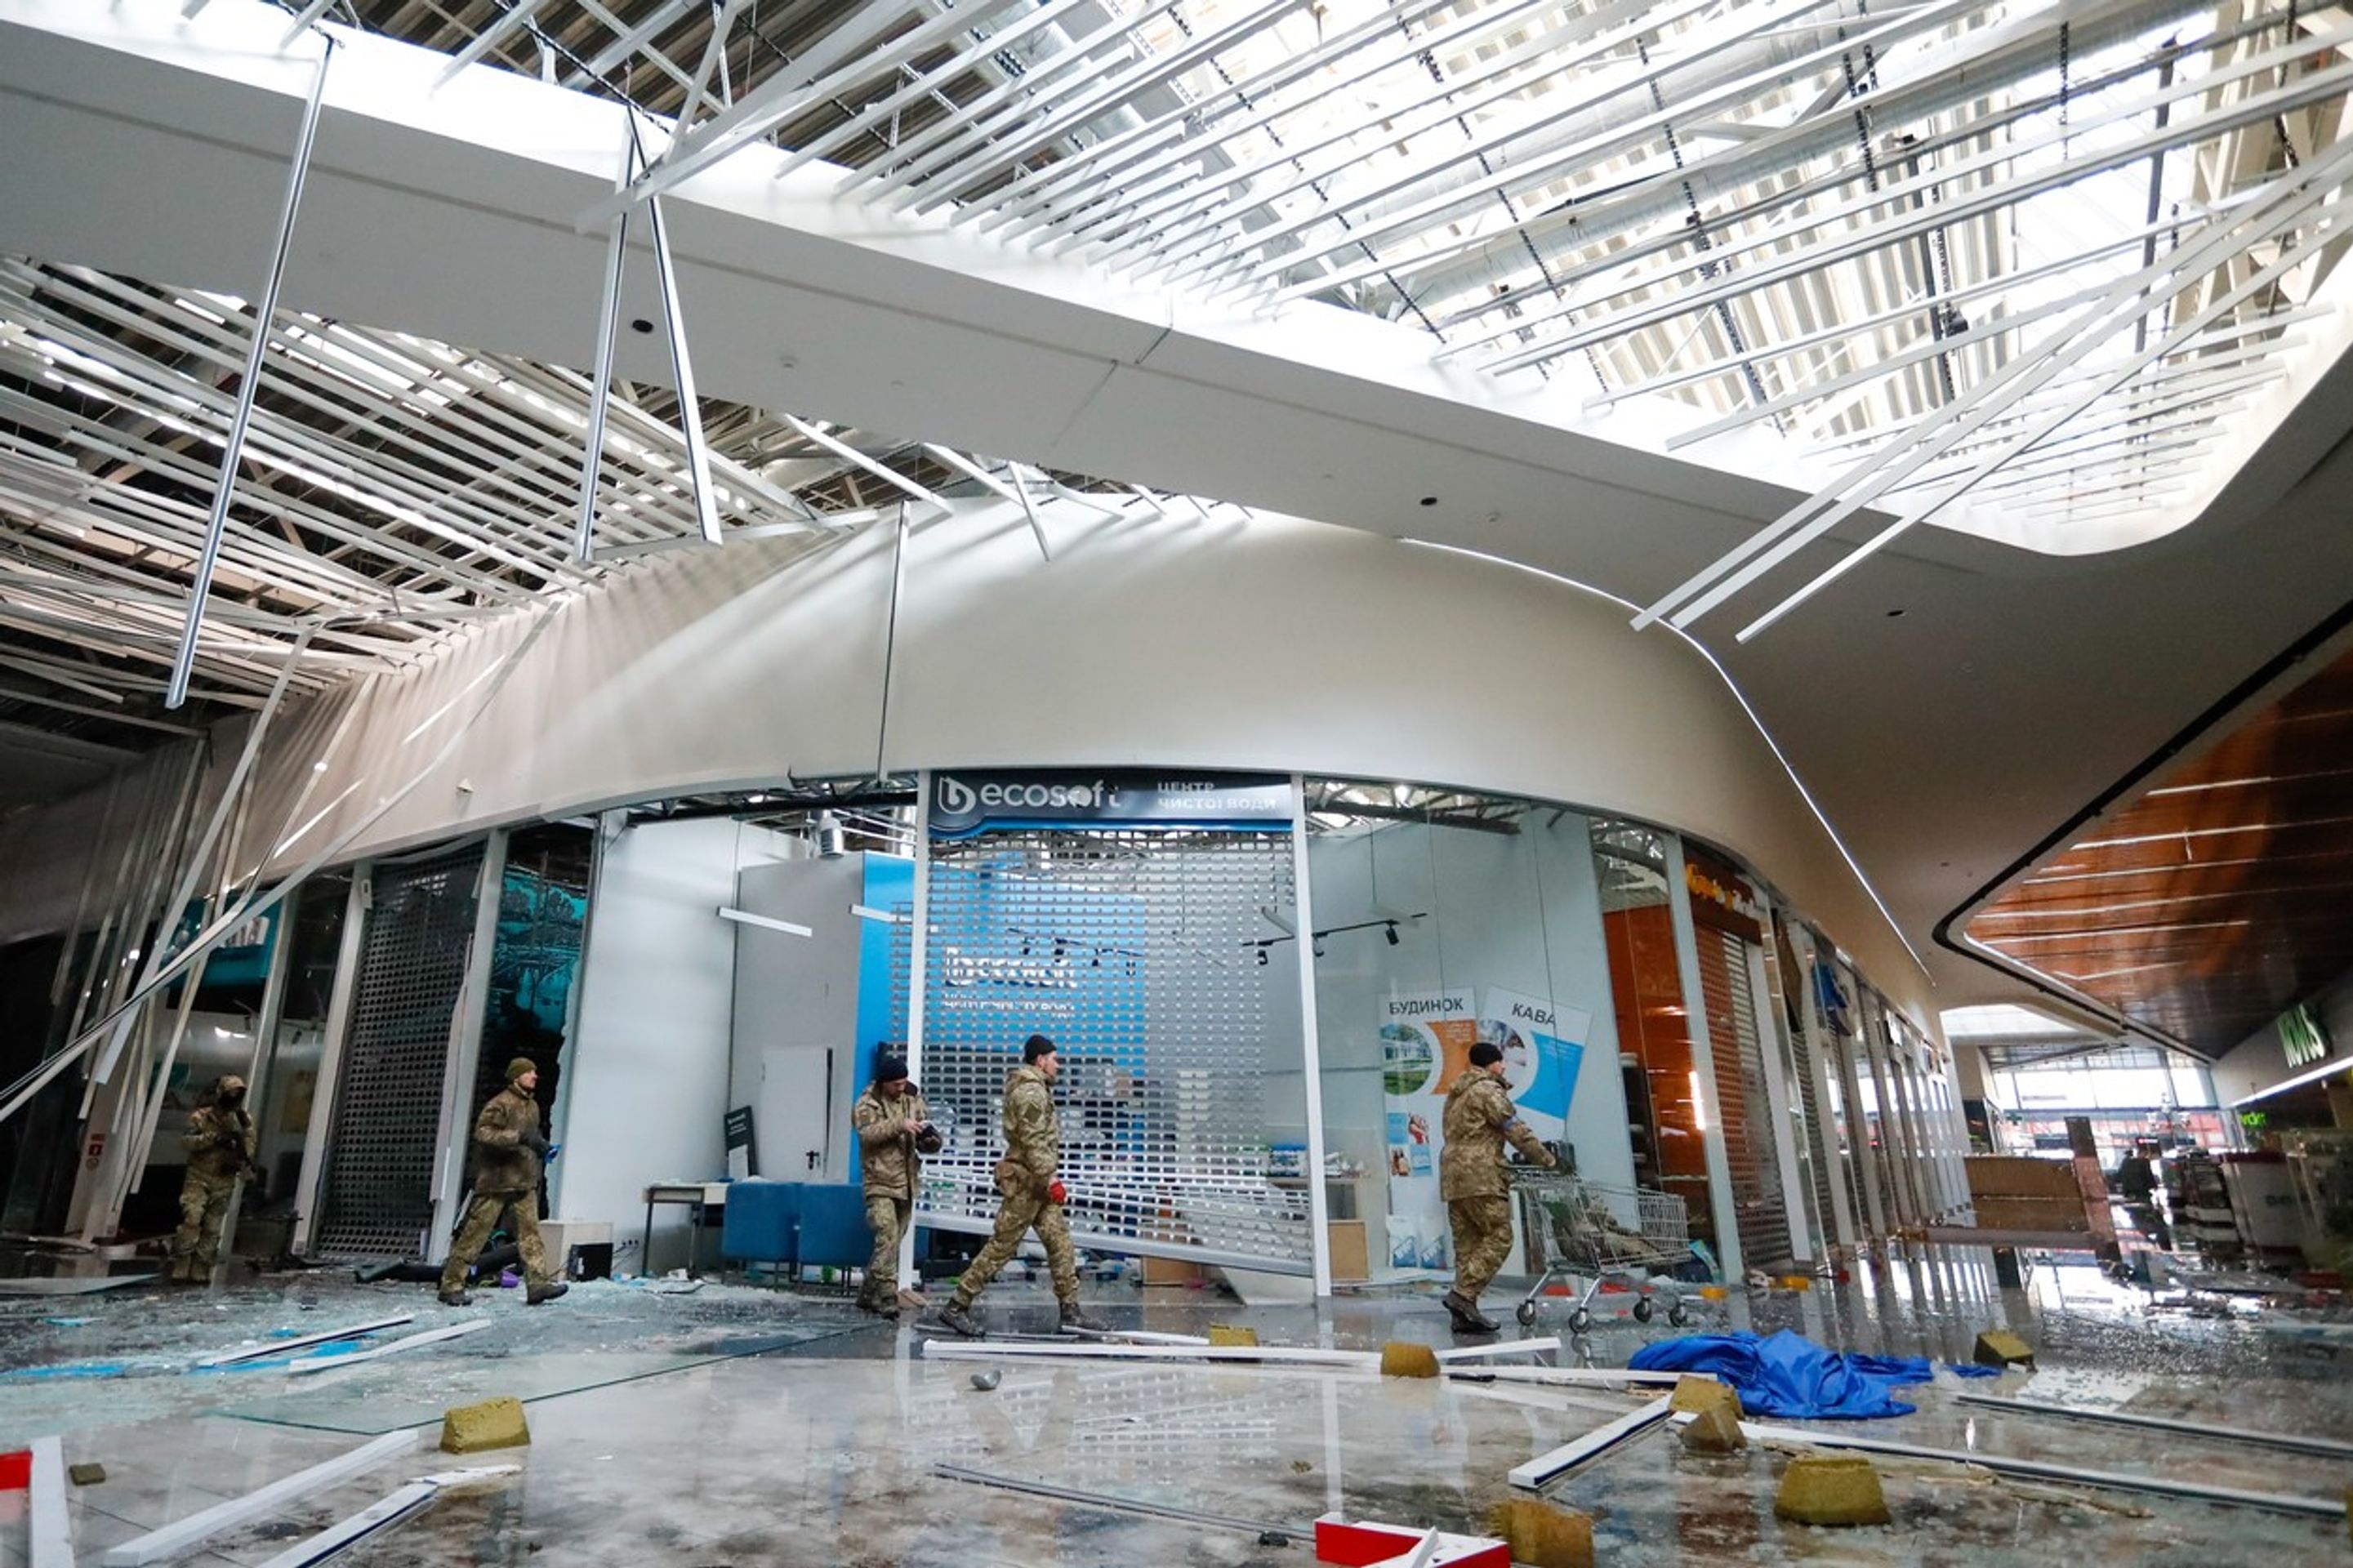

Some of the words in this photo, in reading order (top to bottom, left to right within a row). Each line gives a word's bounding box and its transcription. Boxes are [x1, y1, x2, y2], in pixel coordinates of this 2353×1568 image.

[1157, 782, 1214, 794] ЦЕНТР
[1227, 798, 1276, 810] ВОДИ
[1389, 998, 1464, 1015] БУДИНОК
[1512, 1003, 1557, 1026] КАВА
